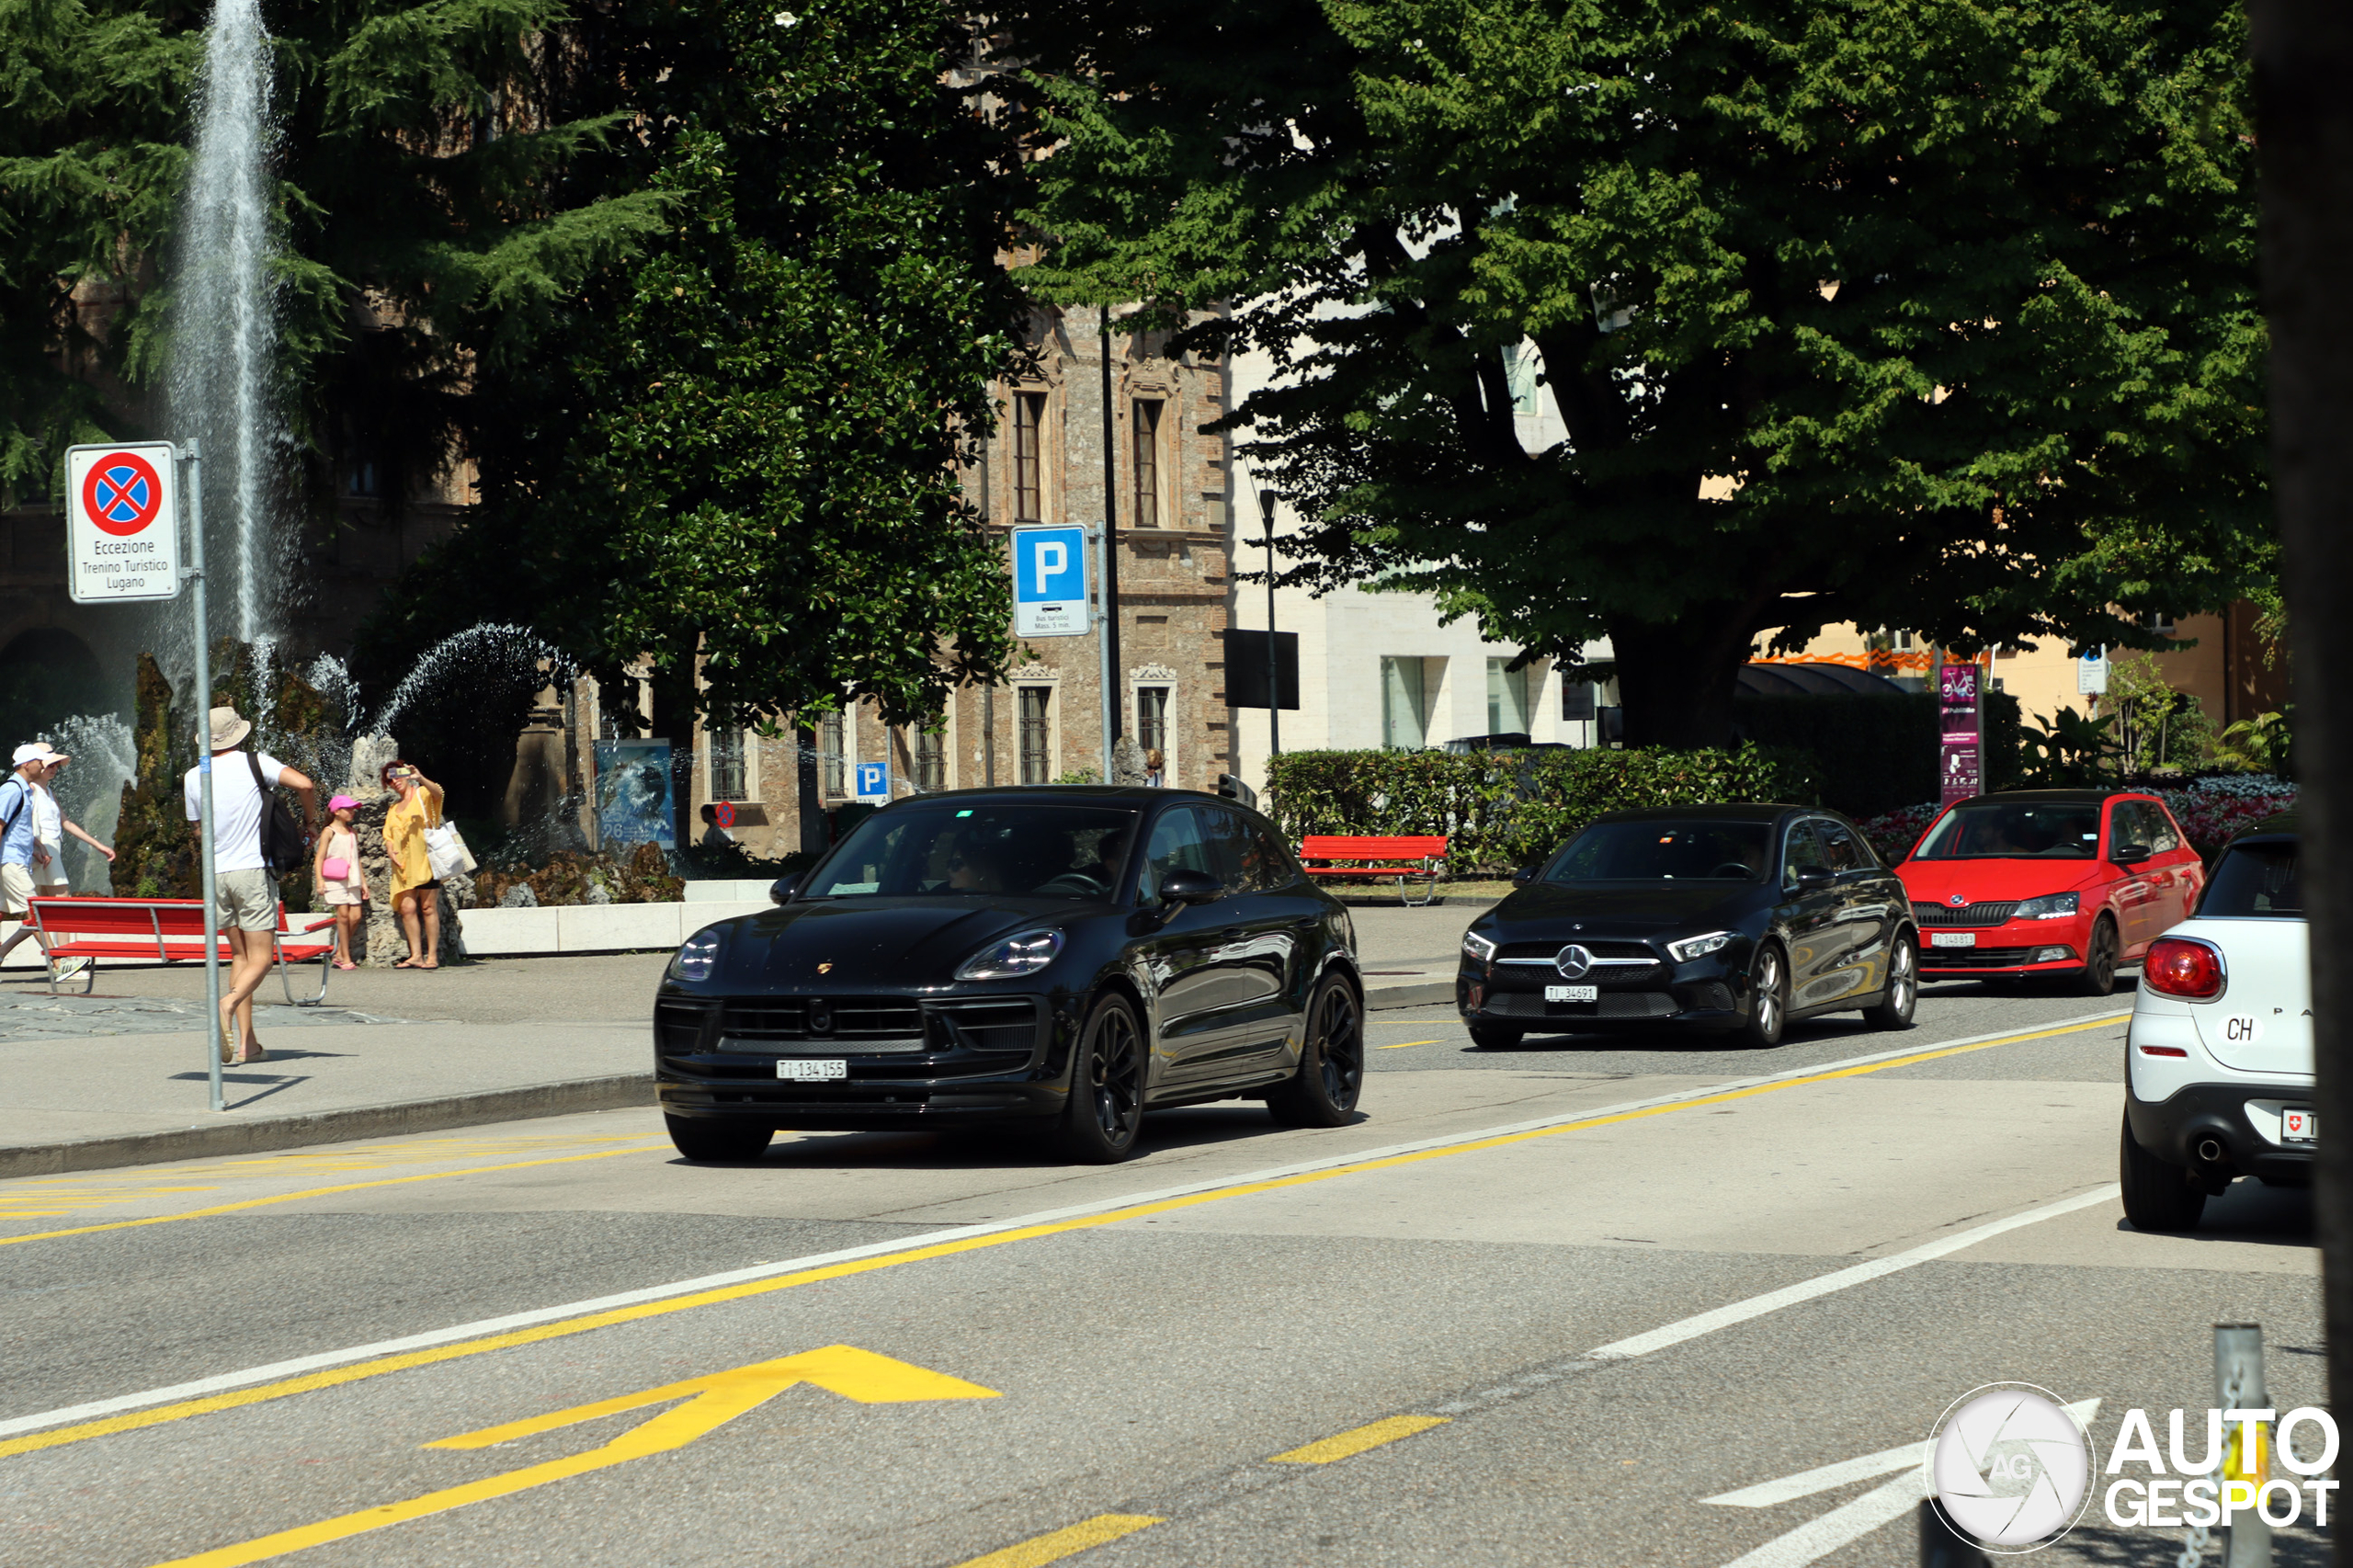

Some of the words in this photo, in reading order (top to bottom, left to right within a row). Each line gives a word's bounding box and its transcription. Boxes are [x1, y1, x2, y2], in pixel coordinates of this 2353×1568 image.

[95, 540, 154, 555] Eccezione
[83, 561, 120, 574] Trenino
[124, 559, 167, 572] Turistico
[1035, 541, 1067, 594] P
[107, 576, 144, 592] Lugano
[865, 768, 881, 792] P
[2227, 1018, 2254, 1040] CH
